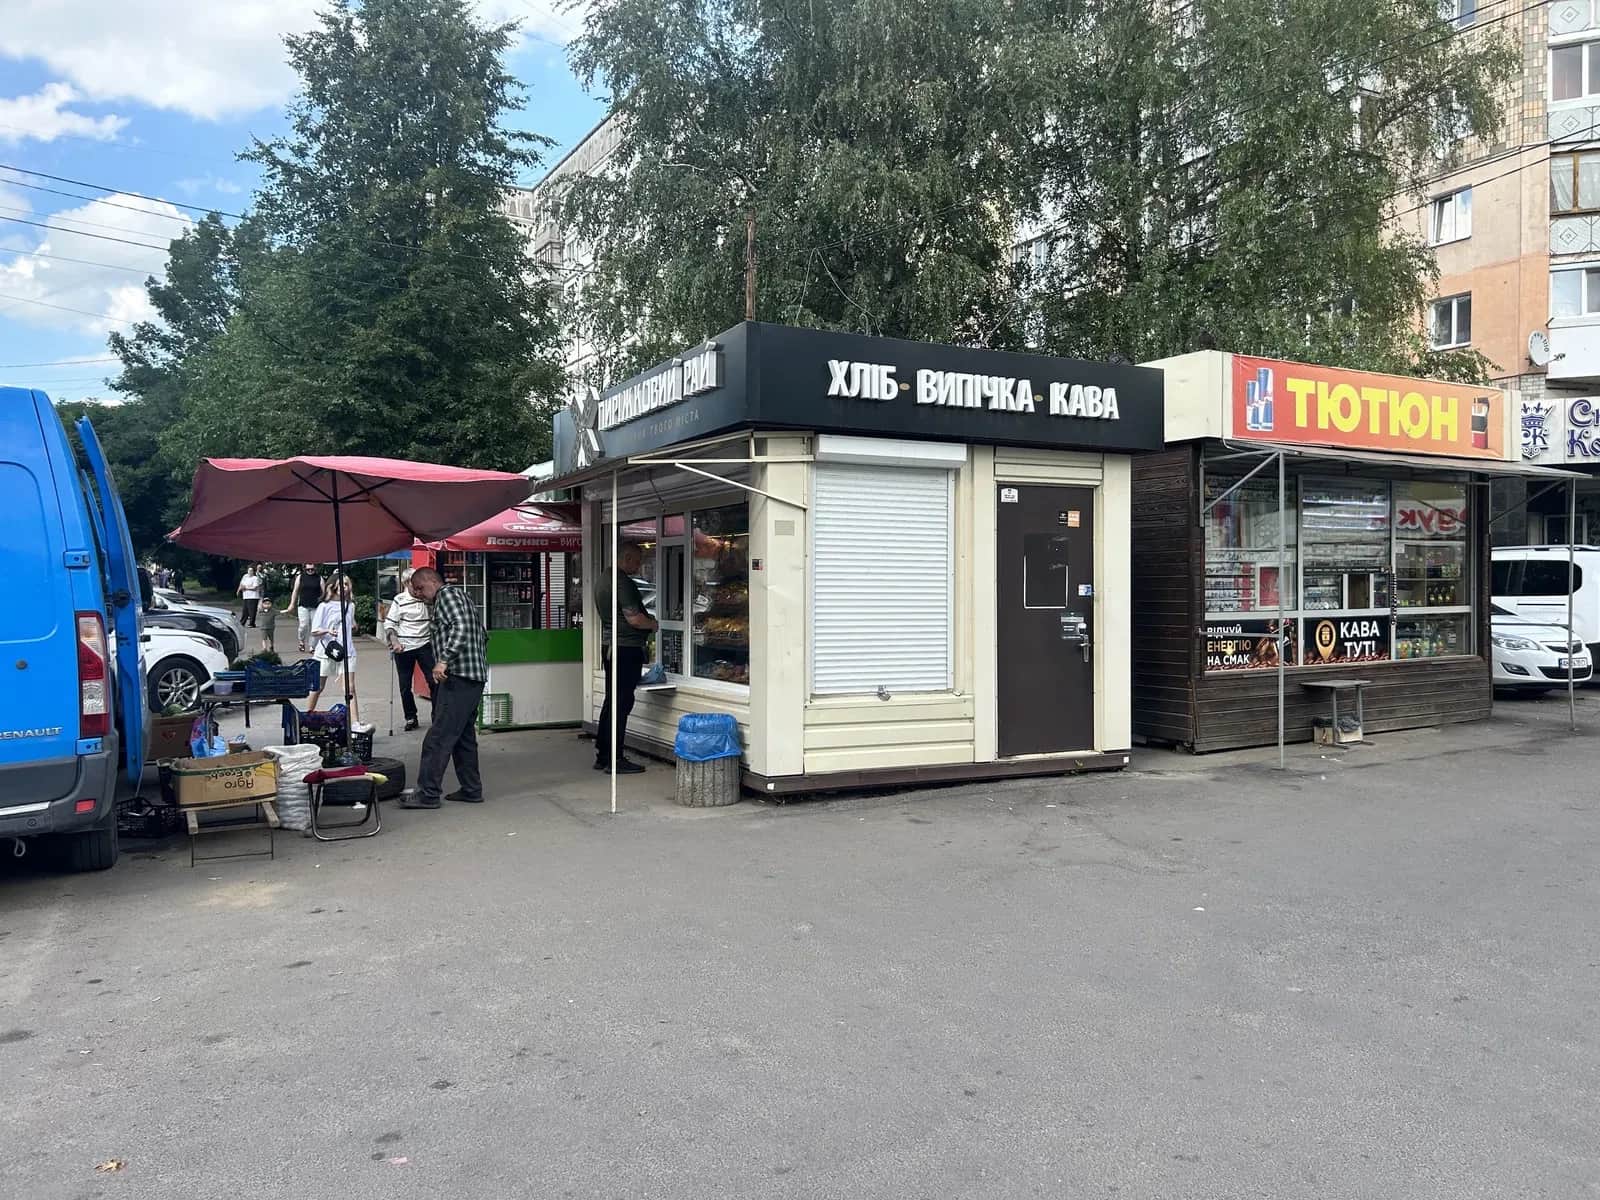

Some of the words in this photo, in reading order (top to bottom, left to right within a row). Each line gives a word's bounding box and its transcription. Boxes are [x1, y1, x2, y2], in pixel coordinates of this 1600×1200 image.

[683, 341, 717, 396] РАЙ
[827, 359, 899, 400] ХЛІБ
[916, 369, 1035, 413] ВИПІЧКА
[1049, 382, 1120, 420] КАВА
[1286, 377, 1458, 441] ТЮТЮН
[486, 537, 549, 547] Ласунка
[1340, 620, 1380, 638] КАВА
[1207, 639, 1252, 653] ЕНЕРГІЮ
[1344, 640, 1376, 658] ТУТ!
[1207, 655, 1221, 666] НА
[1223, 653, 1250, 666] СМАК
[224, 777, 254, 789] Agro
